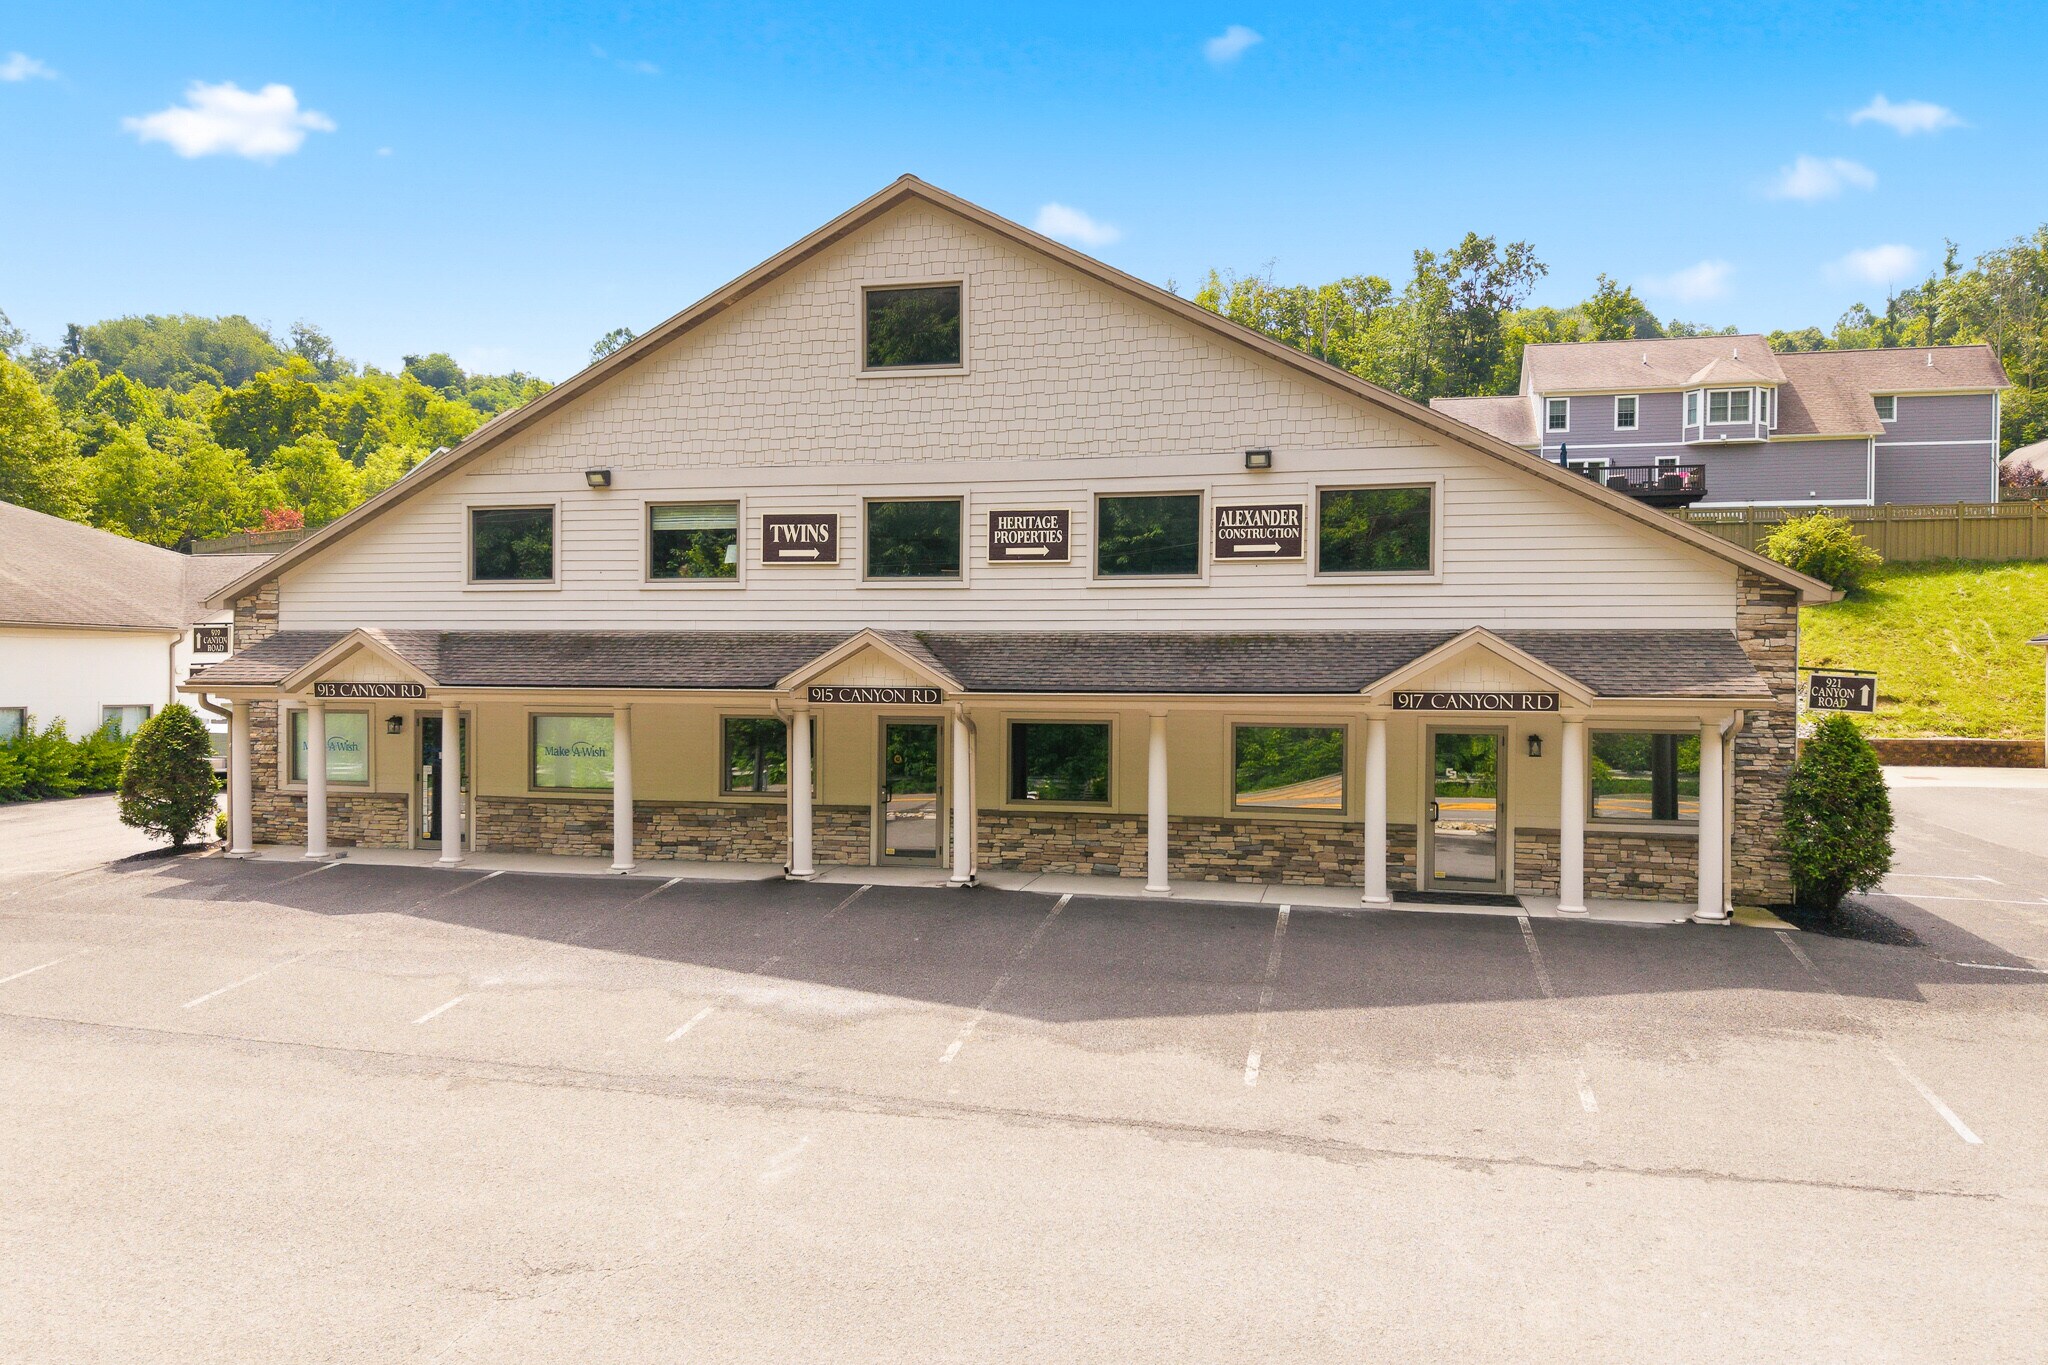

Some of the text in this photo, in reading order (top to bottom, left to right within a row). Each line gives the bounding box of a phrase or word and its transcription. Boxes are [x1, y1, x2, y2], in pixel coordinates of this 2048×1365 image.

[998, 515, 1059, 530] HERITAGE
[1219, 509, 1299, 527] ALEXANDER
[769, 523, 829, 543] TWINS
[994, 529, 1063, 544] PROPERTIES
[1218, 527, 1300, 540] CONSTRUCTION
[317, 683, 423, 697] 913 CANYON RD
[1825, 677, 1842, 688] 921
[812, 688, 938, 703] 915 CANYON RD
[1811, 686, 1855, 699] CANYON
[1398, 693, 1553, 710] 917 CANYON RD
[1817, 696, 1848, 708] ROAD
